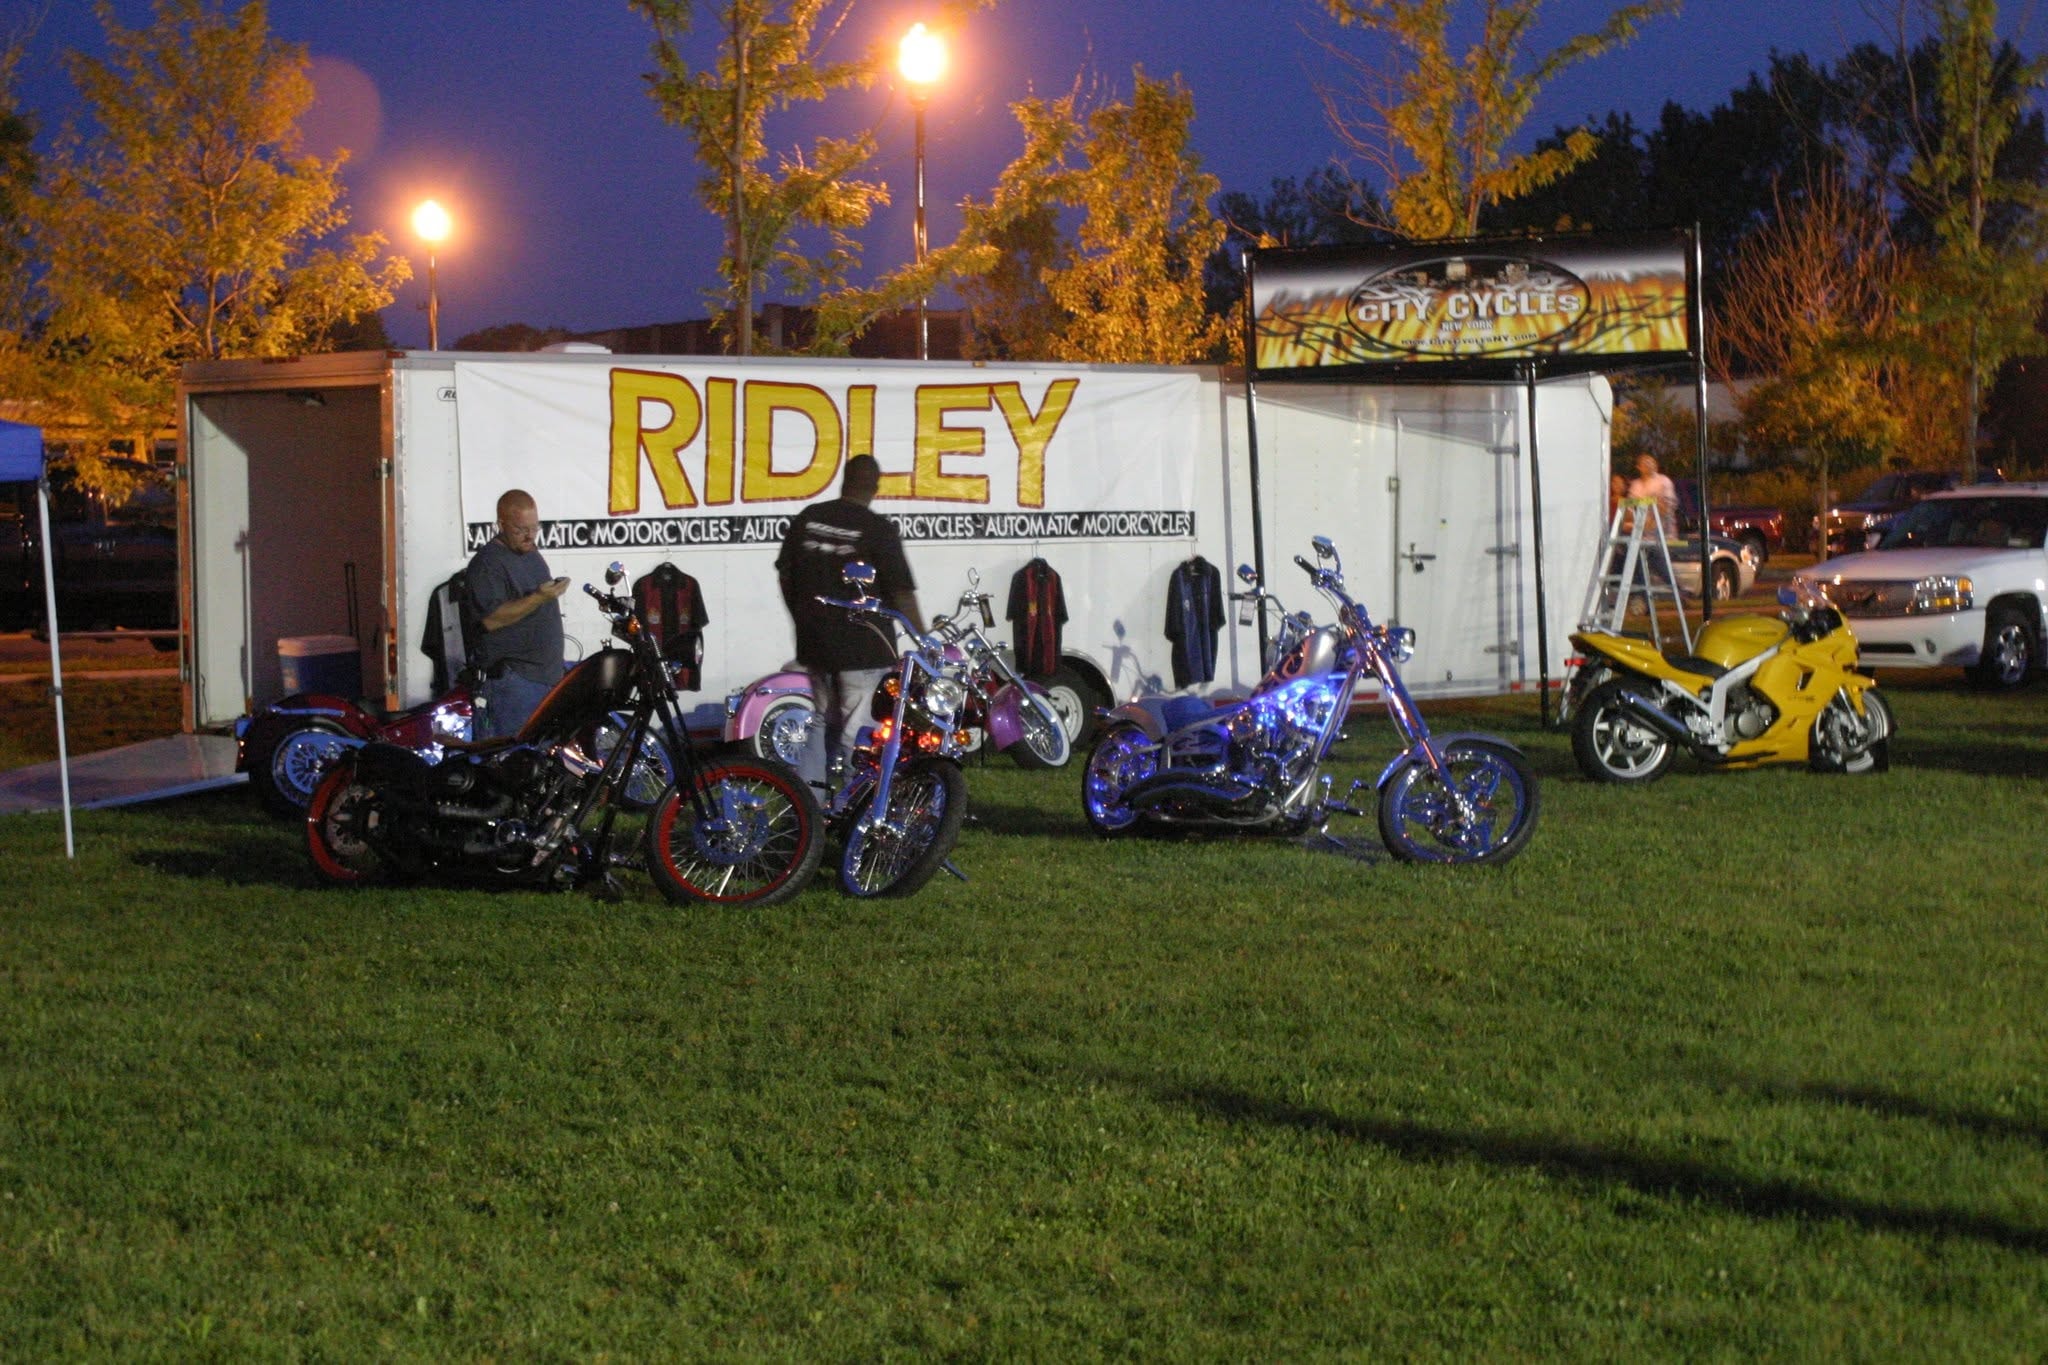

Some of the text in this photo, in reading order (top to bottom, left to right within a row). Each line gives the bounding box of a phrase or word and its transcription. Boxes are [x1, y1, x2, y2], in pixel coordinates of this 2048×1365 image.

[1357, 291, 1581, 322] CITY CYCLES
[1442, 319, 1493, 332] NEW YORK
[608, 366, 1081, 515] RIDLEY
[593, 518, 731, 545] MOTORCYCLES
[890, 515, 975, 538] ORCYCLES
[985, 514, 1080, 538] AUTOMATIC
[1083, 512, 1191, 536] MOTORCYCLES
